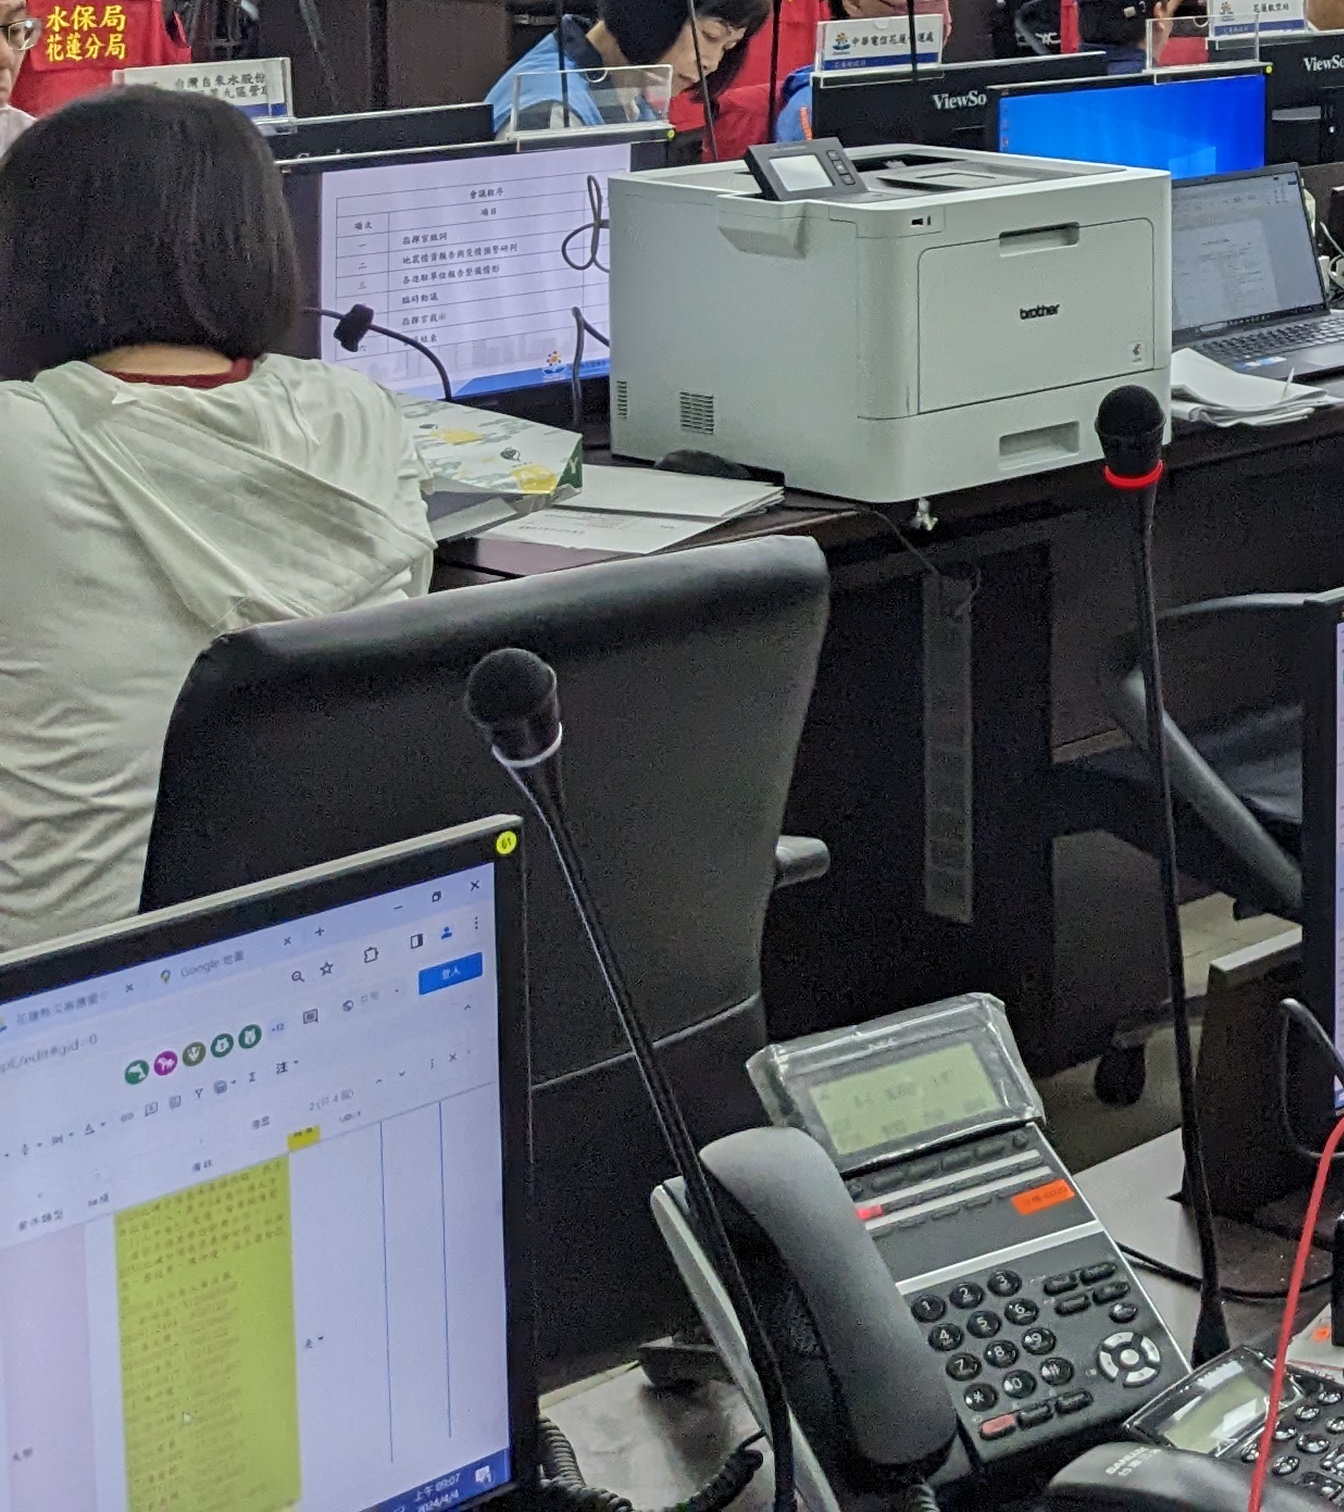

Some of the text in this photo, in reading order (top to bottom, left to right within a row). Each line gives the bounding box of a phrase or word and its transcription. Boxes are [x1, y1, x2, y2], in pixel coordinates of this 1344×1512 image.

[46, 4, 126, 32] 水保局
[46, 33, 126, 63] 花蓮分局
[851, 30, 934, 47] 中華電信花蓮運處
[1019, 304, 1061, 320] brother
